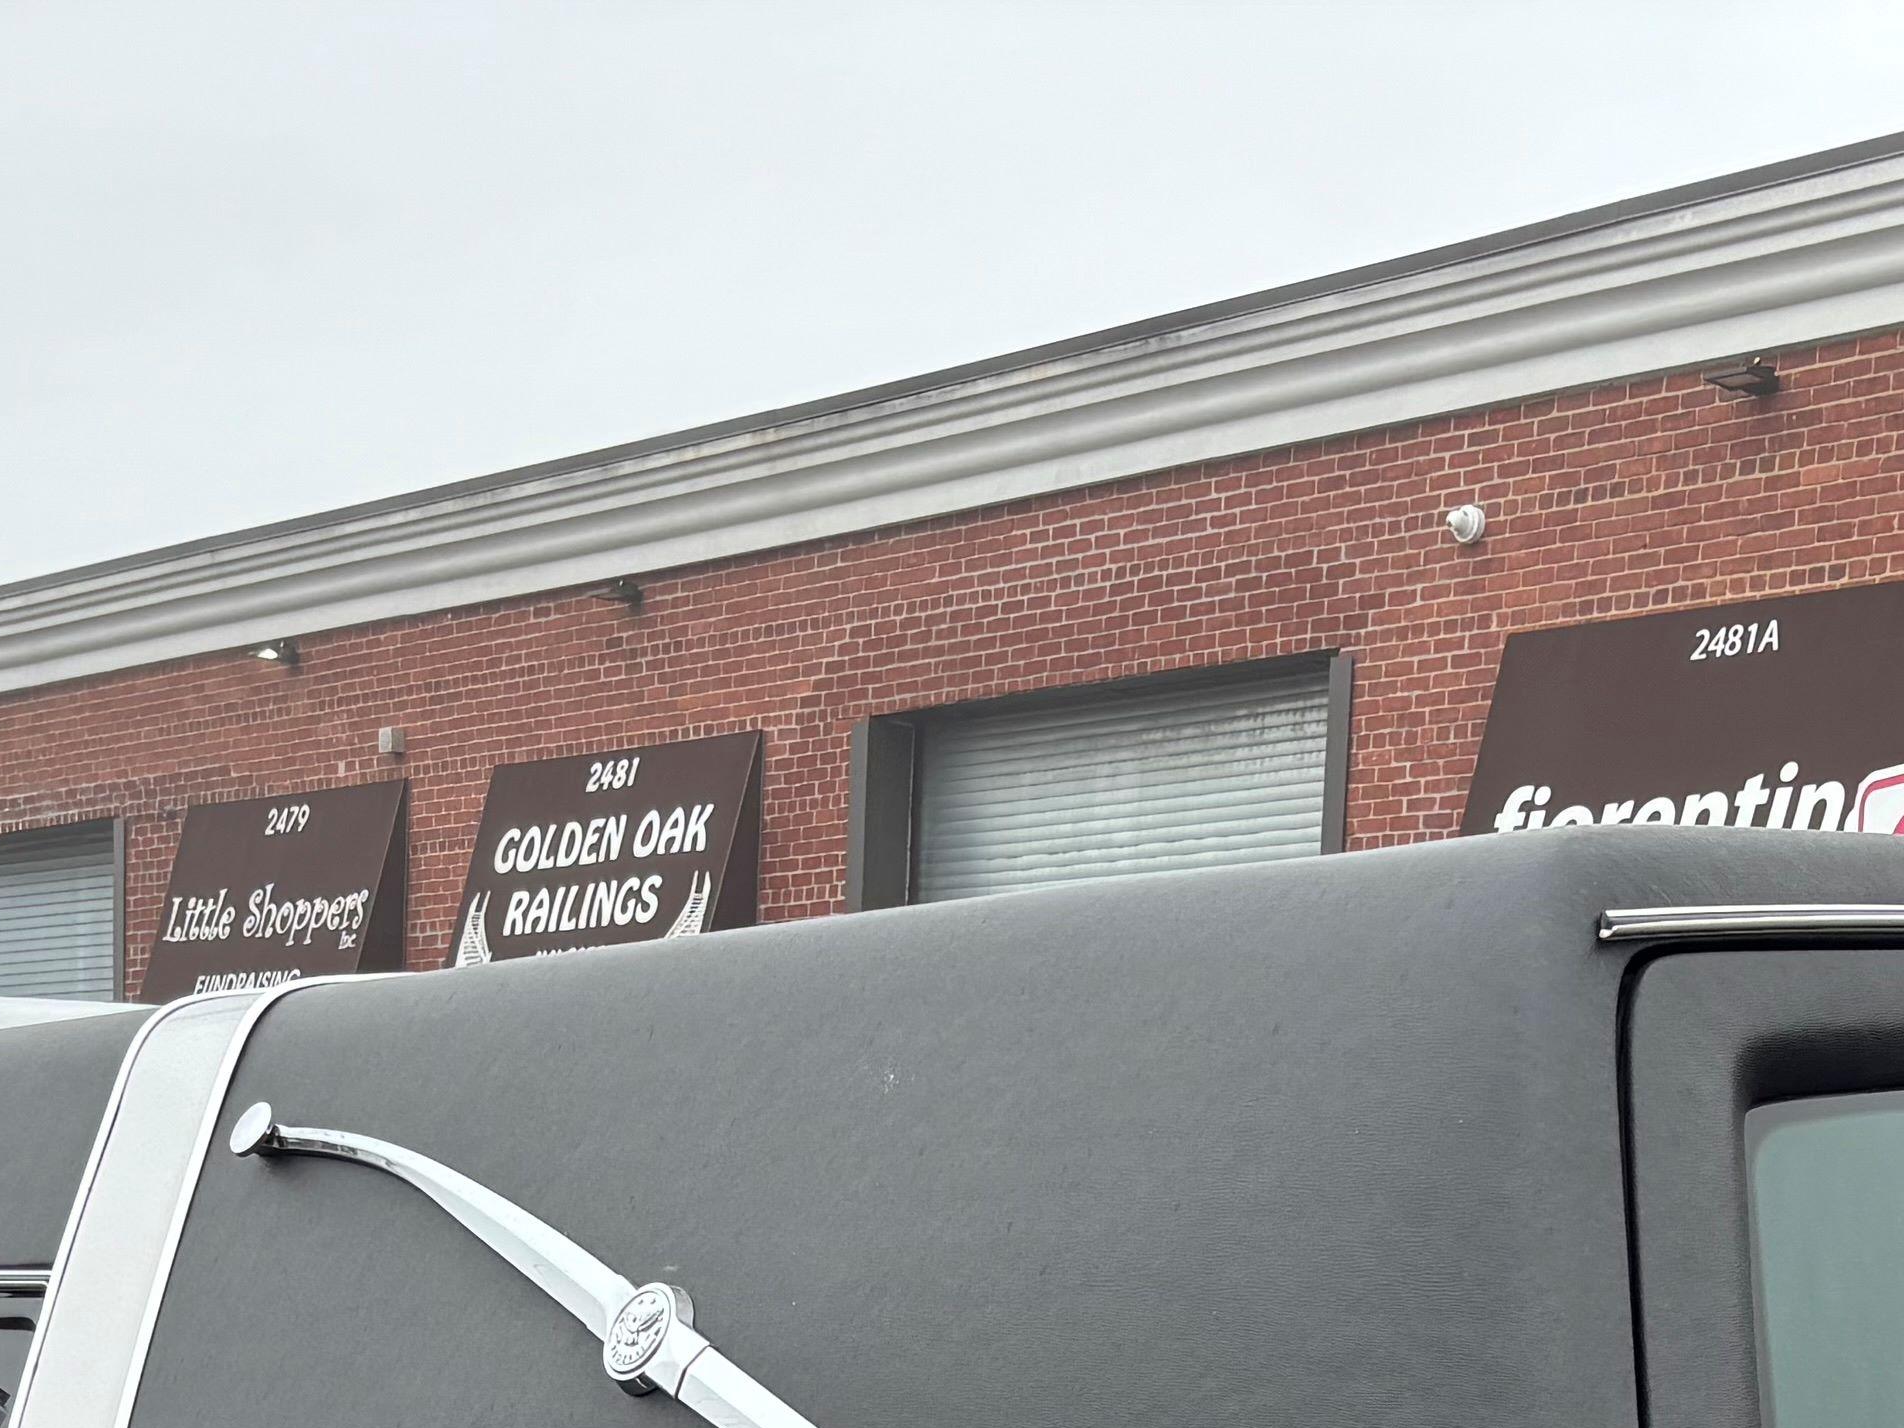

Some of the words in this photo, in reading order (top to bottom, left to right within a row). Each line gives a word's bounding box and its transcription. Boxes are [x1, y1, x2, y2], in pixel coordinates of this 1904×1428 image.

[1689, 619, 1779, 660] 2481A
[585, 757, 641, 792] 2481
[265, 804, 311, 835] 2479
[494, 814, 628, 874] GOLDEN
[633, 803, 714, 858] OAK
[162, 888, 236, 942] Little
[243, 882, 369, 946] Shoppers
[503, 875, 663, 936] RAILINGS
